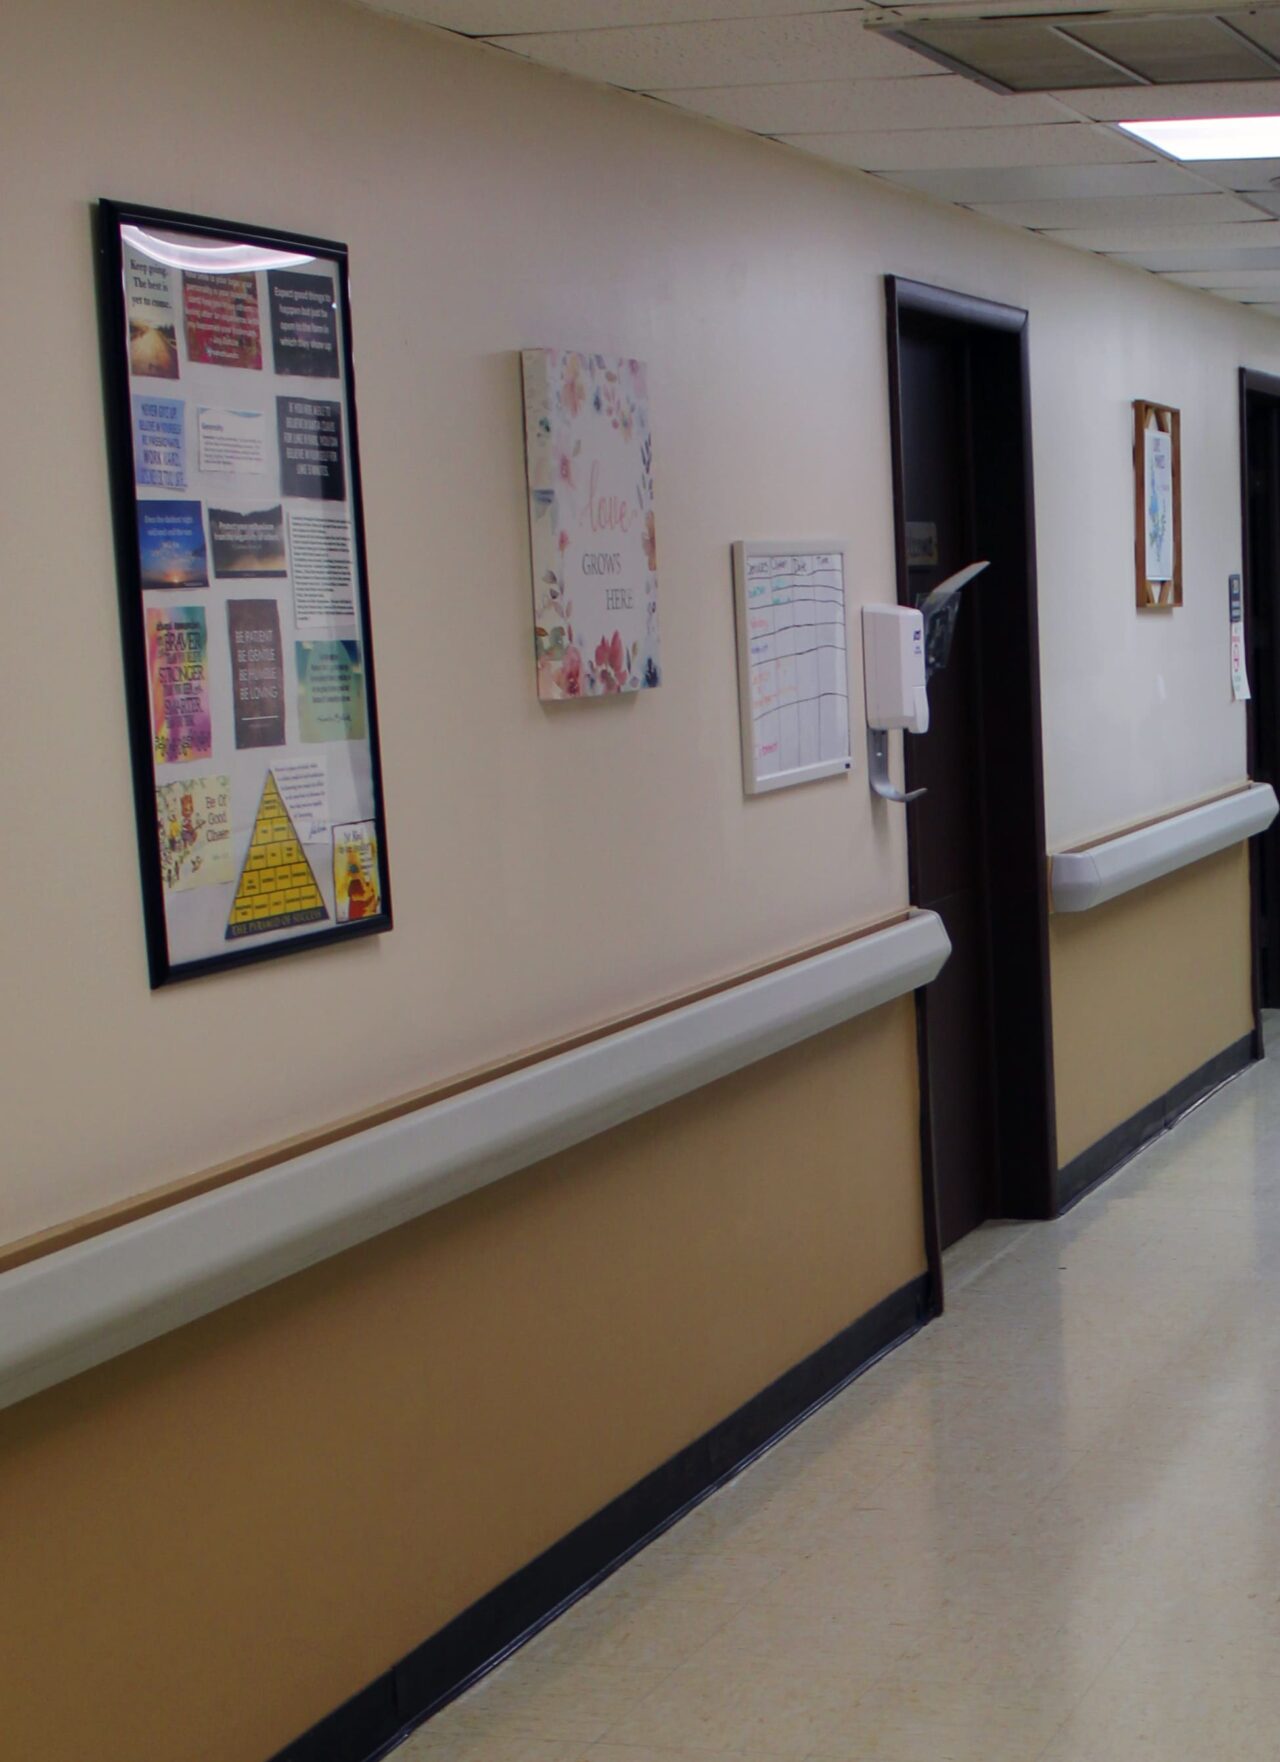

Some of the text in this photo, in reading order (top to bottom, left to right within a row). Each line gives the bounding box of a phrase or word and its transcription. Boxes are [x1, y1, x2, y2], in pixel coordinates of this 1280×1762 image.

[130, 259, 147, 275] Keep
[133, 276, 147, 288] The
[148, 278, 161, 290] best
[131, 296, 143, 308] yet
[143, 297, 151, 306] to
[582, 552, 623, 576] GROWS
[605, 588, 634, 611] HERE
[163, 631, 201, 652] BRAVER
[235, 630, 273, 644] BE PATIENT
[237, 648, 276, 663] BE GENTLE
[158, 665, 204, 684] STRONGER
[239, 667, 248, 682] BE
[240, 686, 279, 701] BE LOVING
[206, 796, 217, 810] Be
[207, 811, 228, 826] Good
[206, 829, 231, 843] Cheer
[231, 922, 249, 937] THE
[250, 917, 279, 934] PYRAMID
[280, 915, 292, 927] OF
